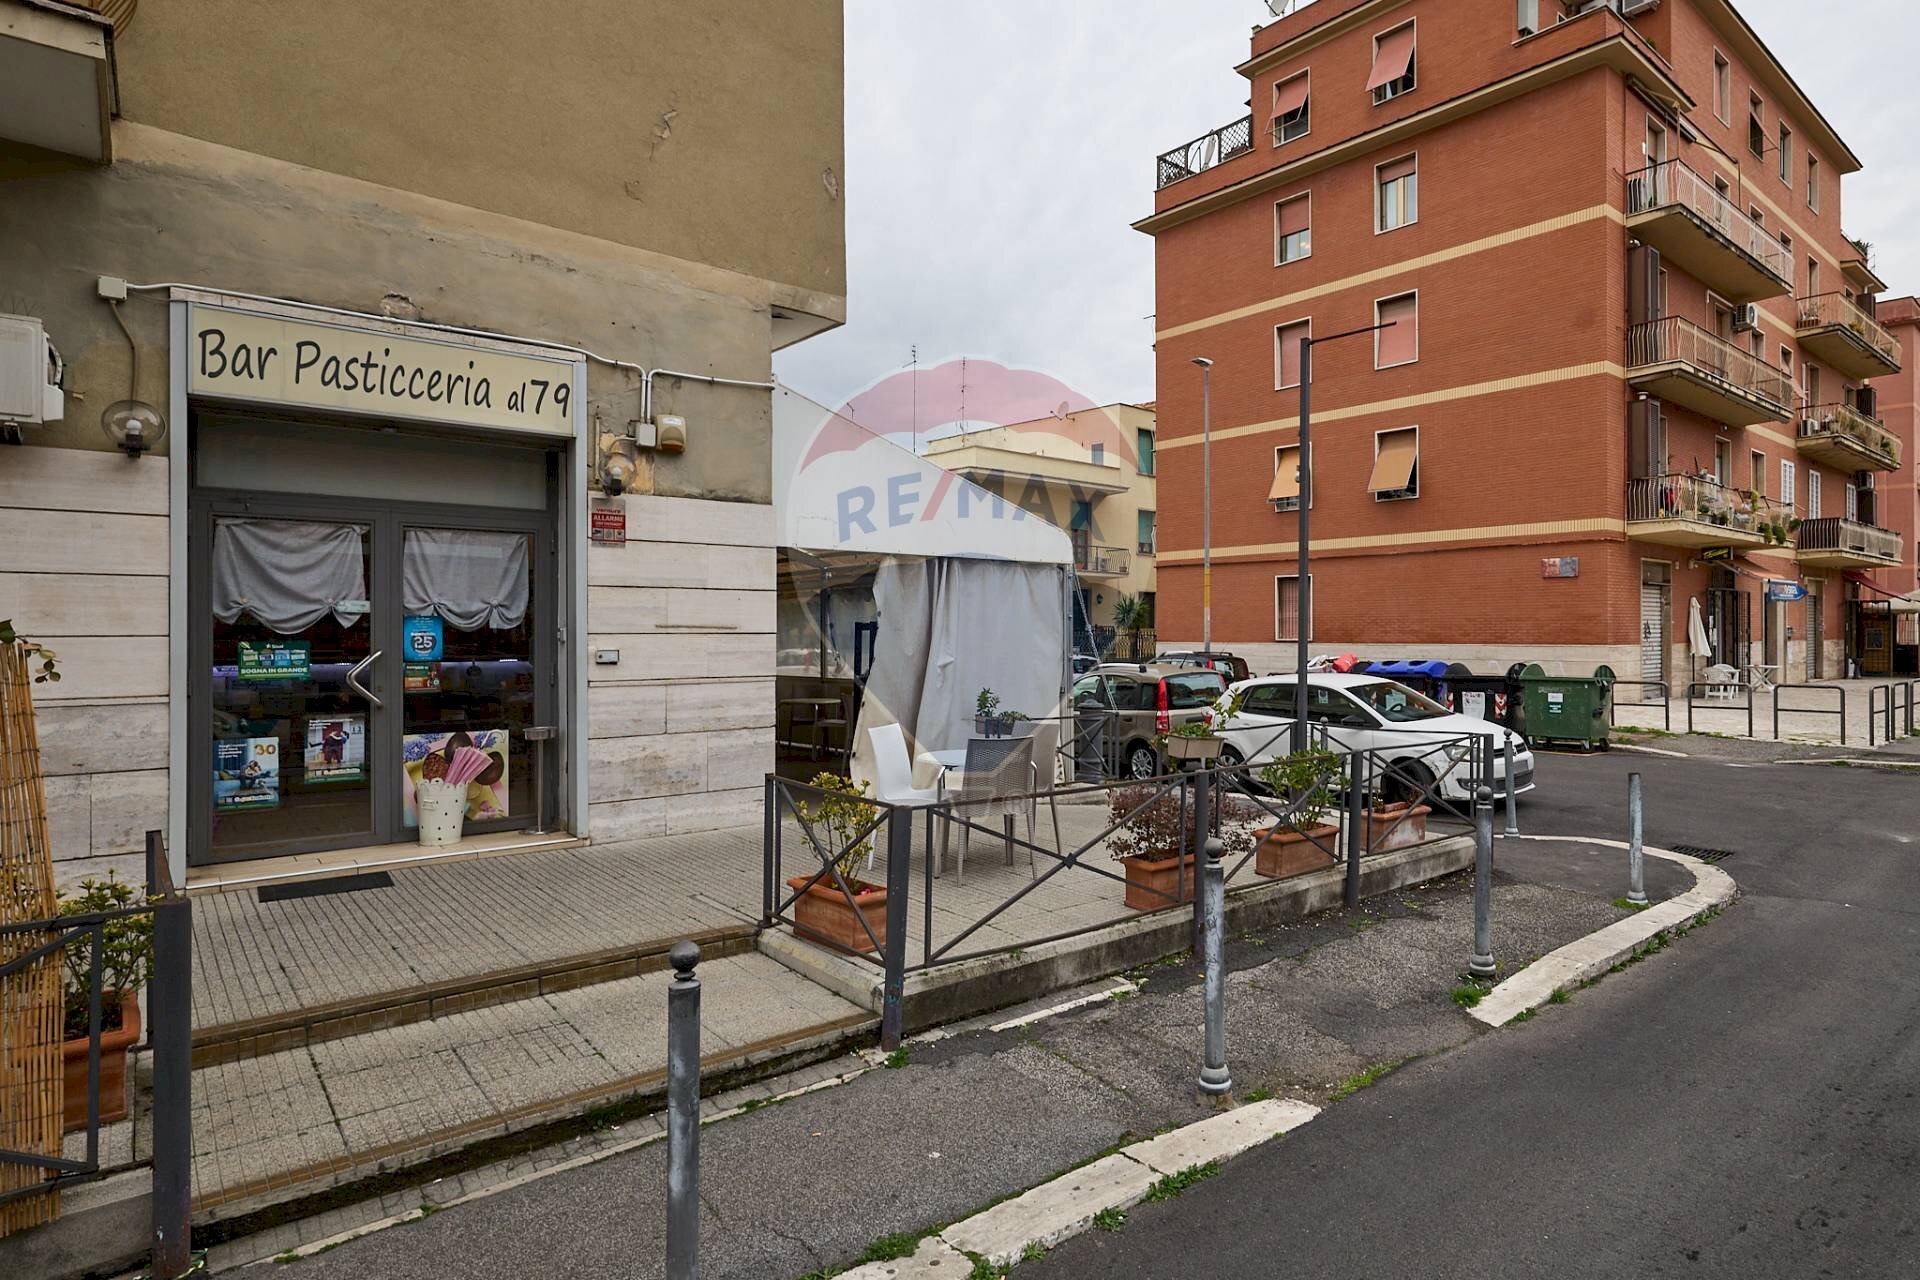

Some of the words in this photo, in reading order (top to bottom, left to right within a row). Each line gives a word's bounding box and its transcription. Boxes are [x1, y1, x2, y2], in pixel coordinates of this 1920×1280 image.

[198, 328, 278, 380] Bar
[294, 340, 491, 410] Pasticceria
[593, 514, 624, 522] ALLARME
[414, 636, 433, 649] 25
[255, 744, 276, 756] 30
